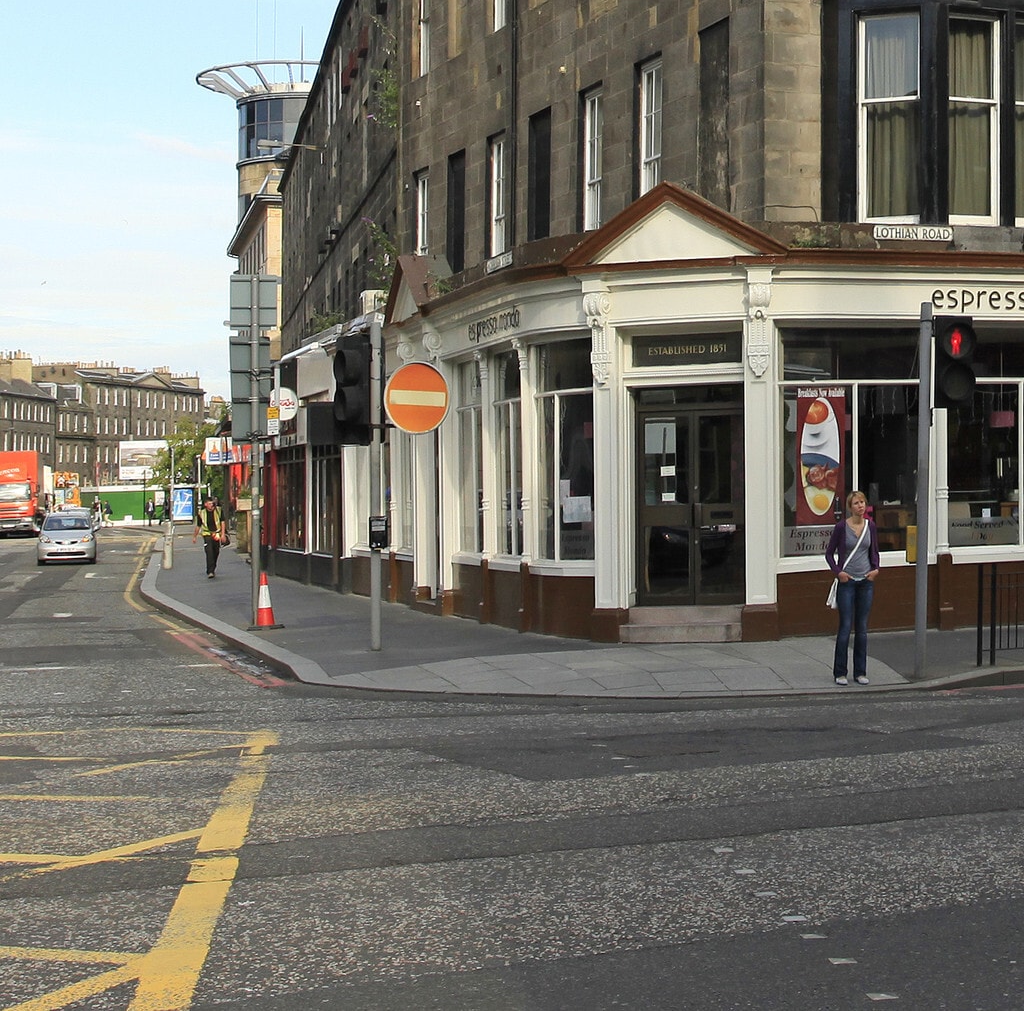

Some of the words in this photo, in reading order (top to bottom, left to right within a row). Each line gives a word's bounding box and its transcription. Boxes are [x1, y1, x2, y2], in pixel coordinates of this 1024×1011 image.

[876, 226, 918, 239] LOTHIAN
[922, 229, 950, 240] ROAD
[648, 345, 705, 356] ESTABLISHED
[710, 344, 727, 353] 1851
